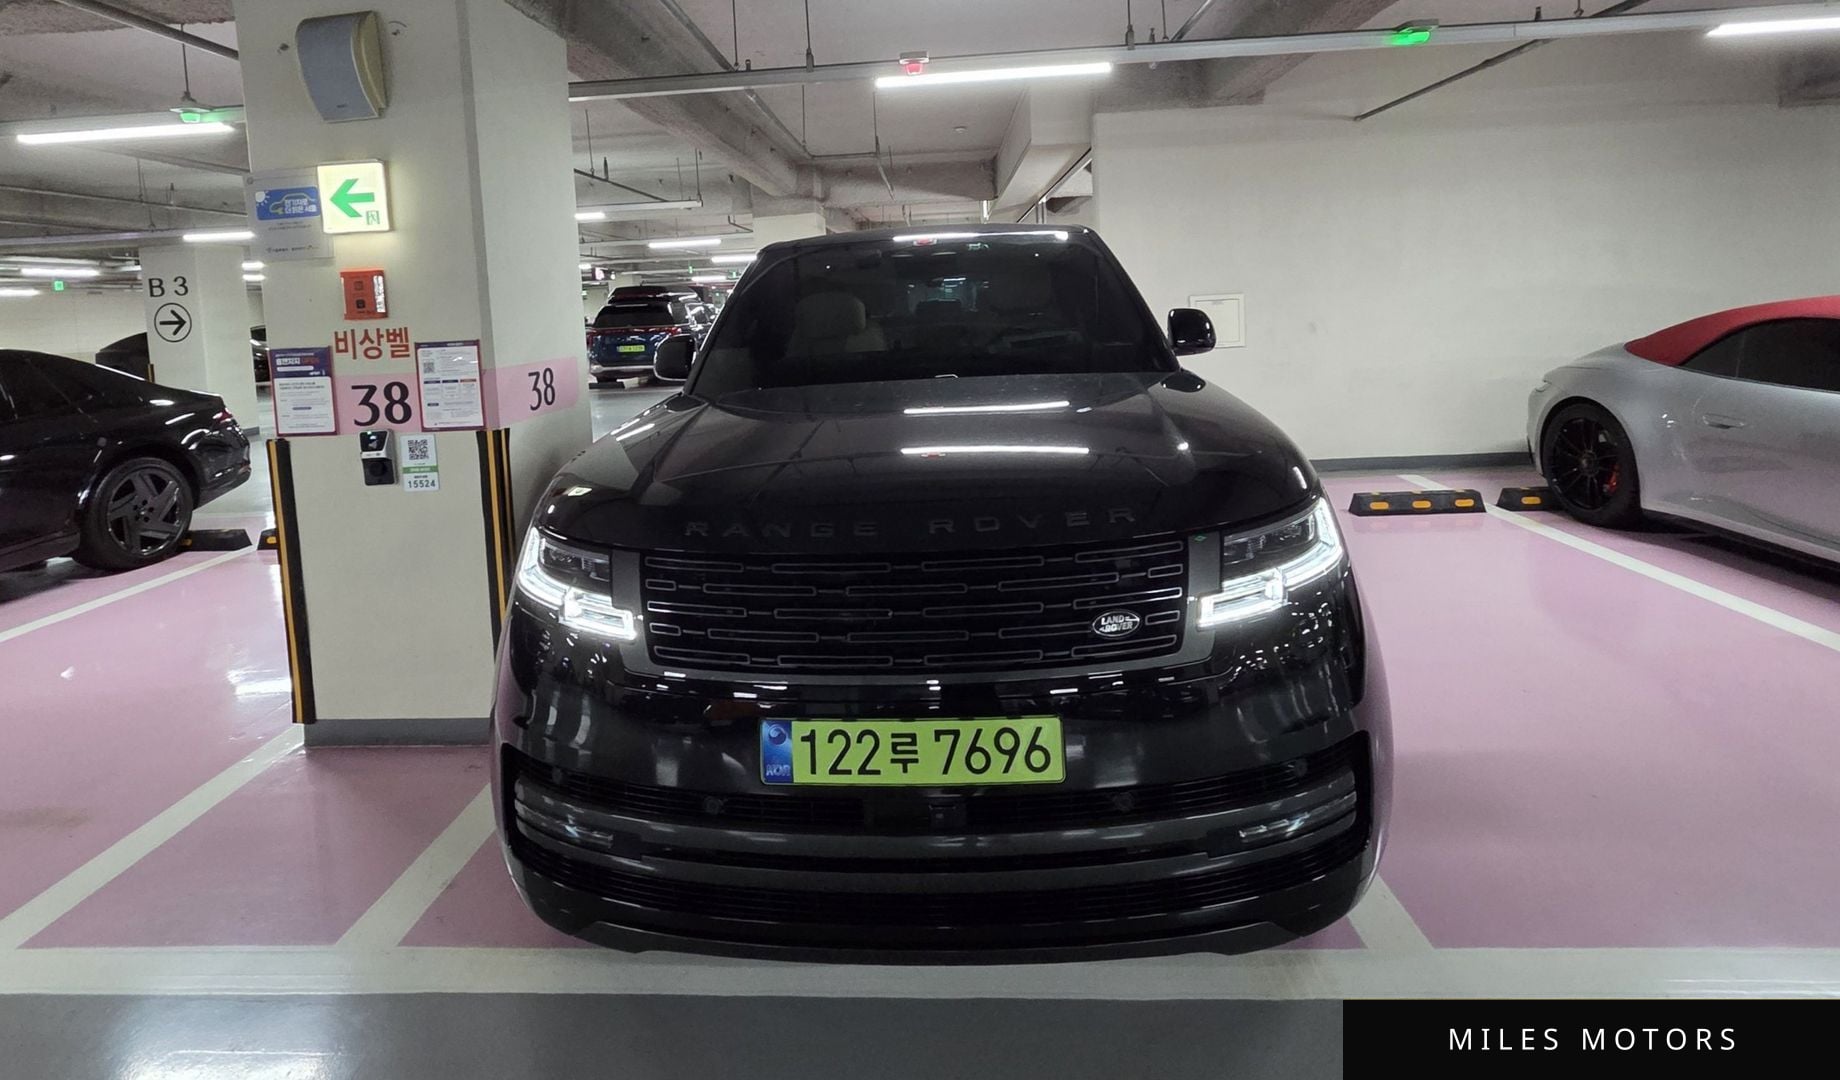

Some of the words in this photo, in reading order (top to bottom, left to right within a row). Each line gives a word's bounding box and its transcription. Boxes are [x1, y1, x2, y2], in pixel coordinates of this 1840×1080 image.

[148, 277, 165, 298] B
[173, 275, 189, 296] 3
[334, 326, 411, 360] 비상벨
[351, 381, 412, 427] 38
[527, 367, 556, 411] 38
[408, 479, 436, 488] 15524
[684, 520, 878, 538] RANGE
[928, 507, 1137, 534] ROVER
[1101, 614, 1125, 626] LAND
[1104, 621, 1133, 633] ROVER
[934, 726, 1051, 776] 7696
